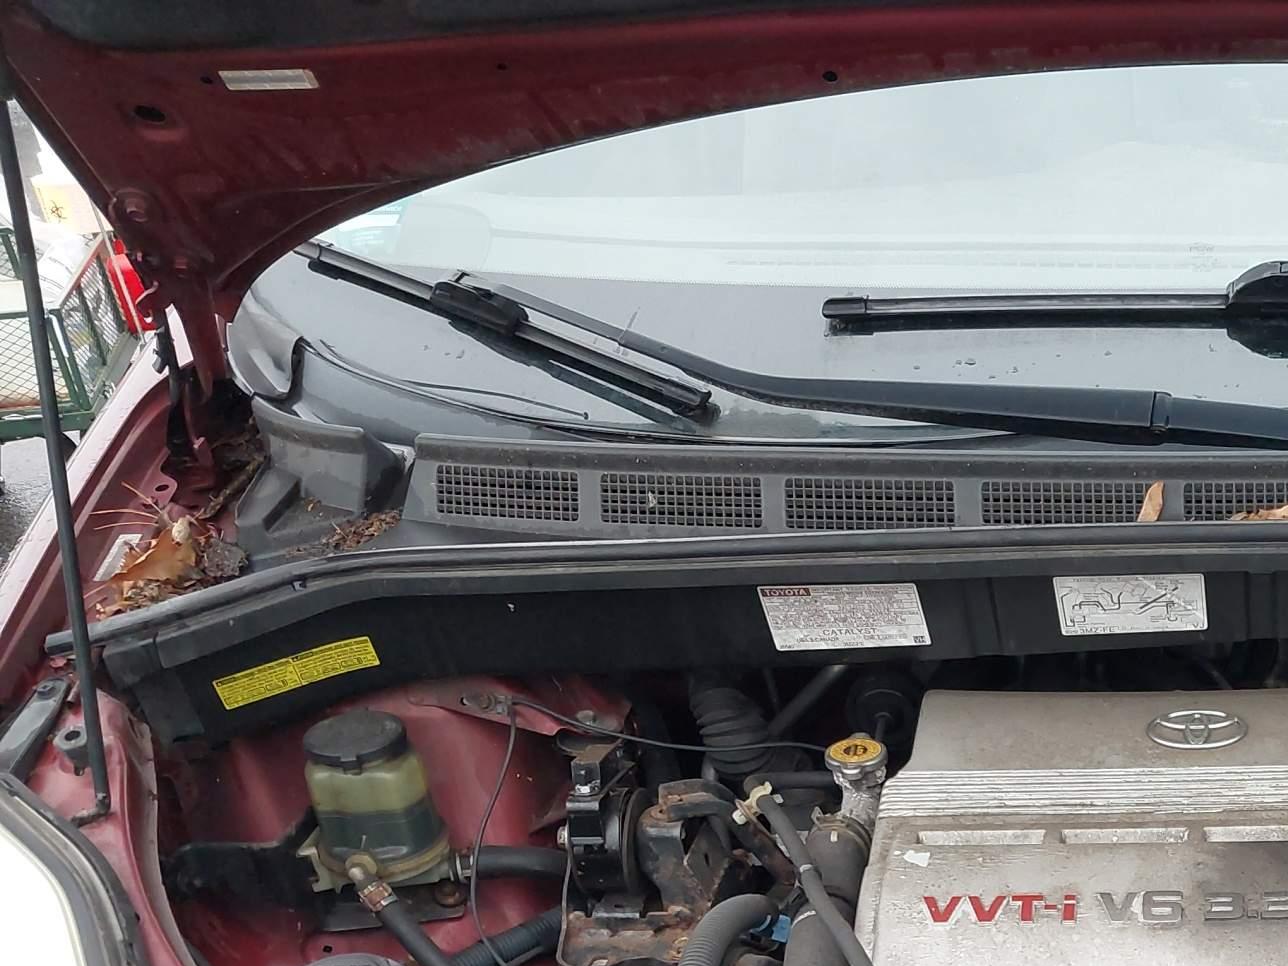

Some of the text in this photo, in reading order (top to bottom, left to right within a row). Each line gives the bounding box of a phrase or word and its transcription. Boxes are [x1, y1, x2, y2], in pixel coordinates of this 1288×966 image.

[822, 627, 878, 636] CATALYST
[922, 893, 1077, 926] VVT-i
[1096, 890, 1185, 924] V6
